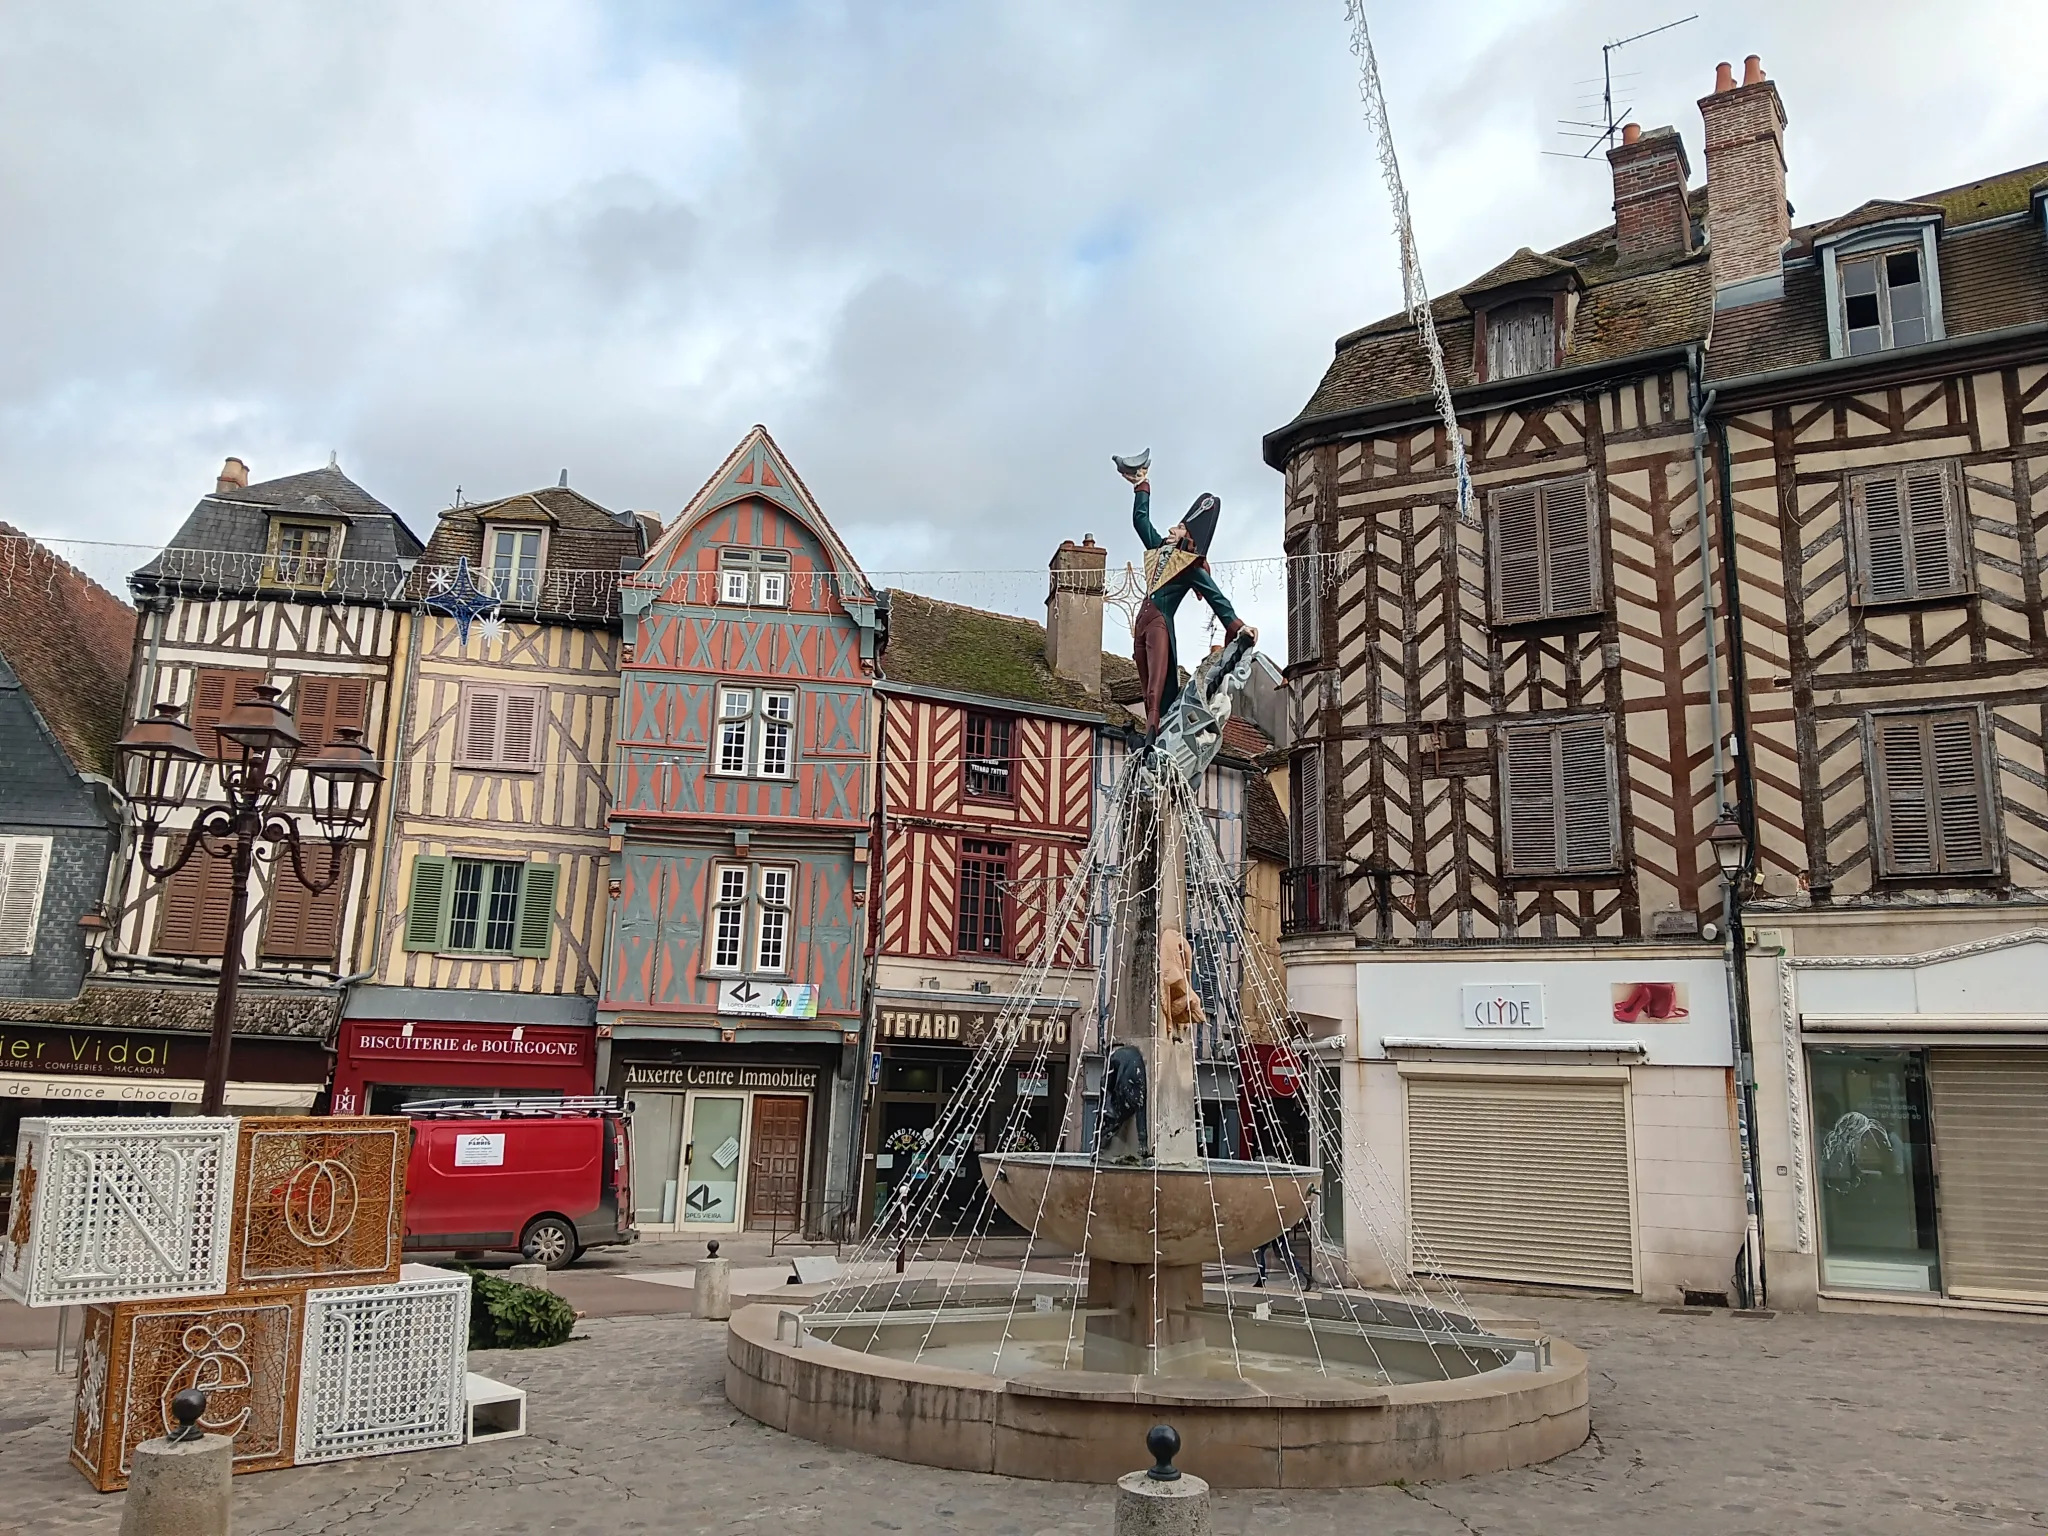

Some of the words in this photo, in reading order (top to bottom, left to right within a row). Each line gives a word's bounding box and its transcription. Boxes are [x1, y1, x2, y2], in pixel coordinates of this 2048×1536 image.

[881, 1011, 961, 1040] TETARD
[1475, 998, 1531, 1026] CLYDE
[69, 1035, 169, 1065] Vidal
[359, 1036, 459, 1051] BISCUITERIE
[462, 1038, 478, 1052] de
[481, 1039, 578, 1056] BOURGOGNE
[45, 1062, 103, 1072] CONFISERIES
[114, 1065, 166, 1075] MACARONS
[625, 1064, 683, 1084] Auxerre
[687, 1065, 734, 1085] Centre
[738, 1067, 817, 1087] Immobilier
[8, 1083, 31, 1096] de
[45, 1083, 105, 1098] France
[121, 1087, 230, 1103] Chocolar
[56, 1143, 220, 1281] N
[323, 1305, 445, 1438] L
